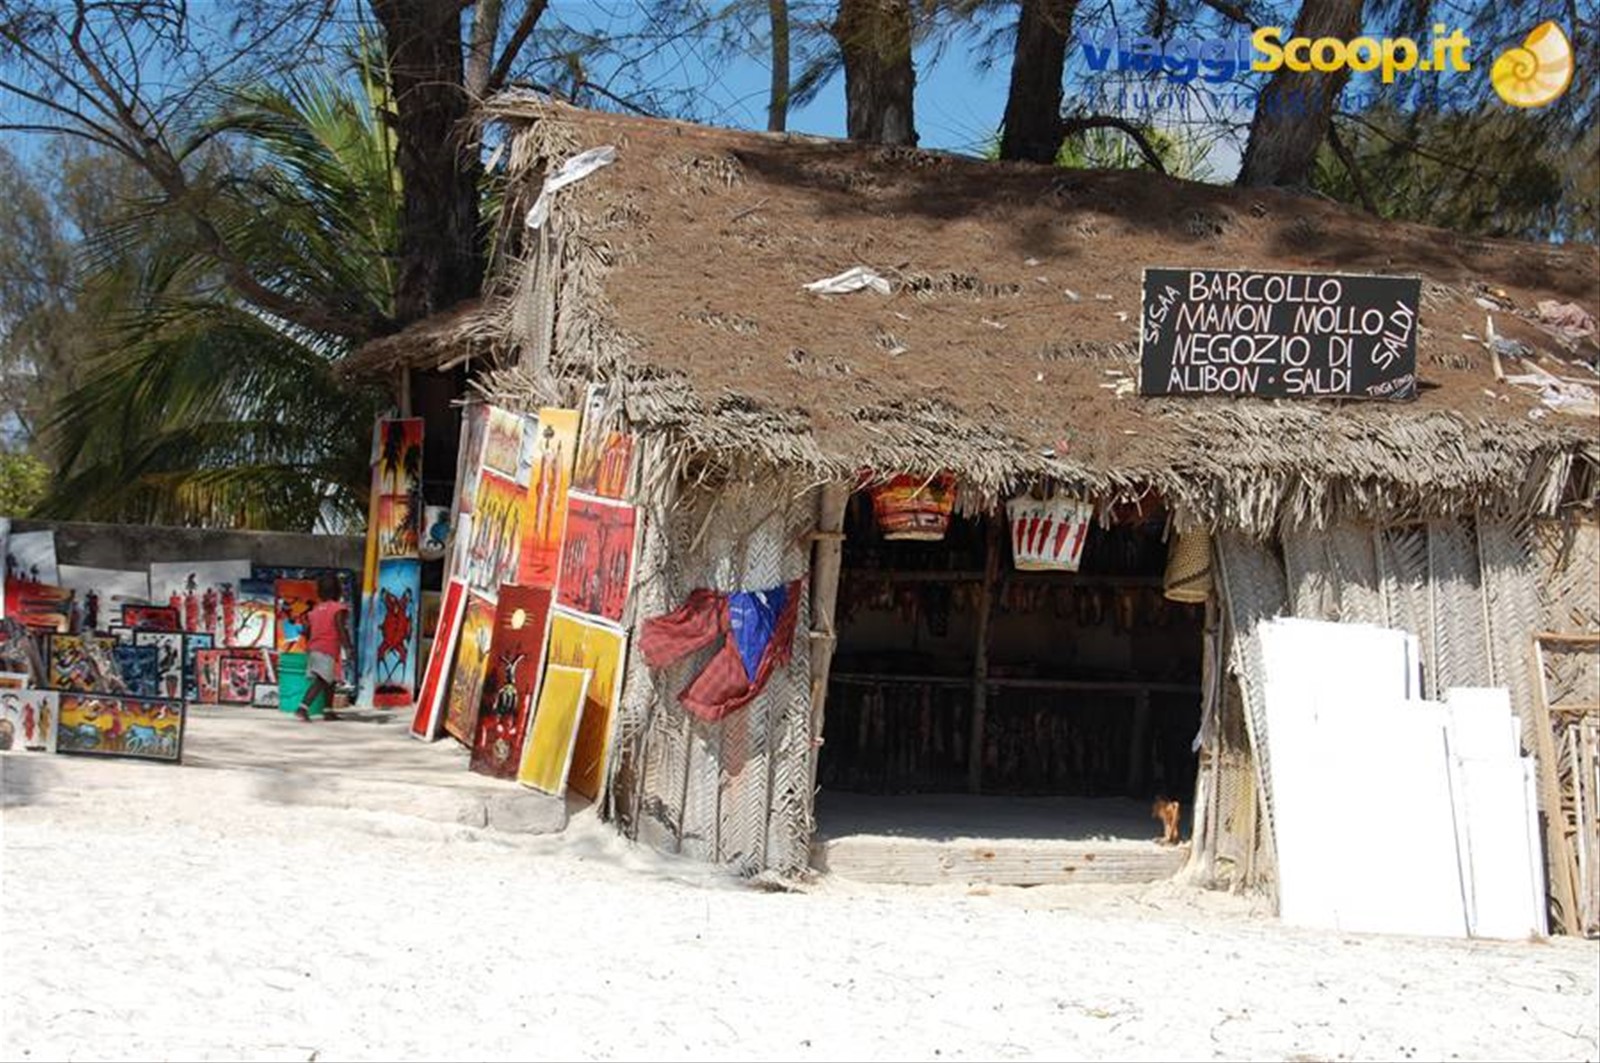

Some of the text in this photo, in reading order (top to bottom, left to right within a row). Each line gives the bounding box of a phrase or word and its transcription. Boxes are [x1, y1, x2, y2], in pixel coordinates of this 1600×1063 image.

[1189, 272, 1342, 304] BARCOLLO
[1174, 303, 1384, 336] MANON MOLLO
[1371, 300, 1415, 371] SALDI
[1171, 334, 1353, 367] NEGOZIO DI
[1167, 365, 1352, 394] ALIBON SALDI
